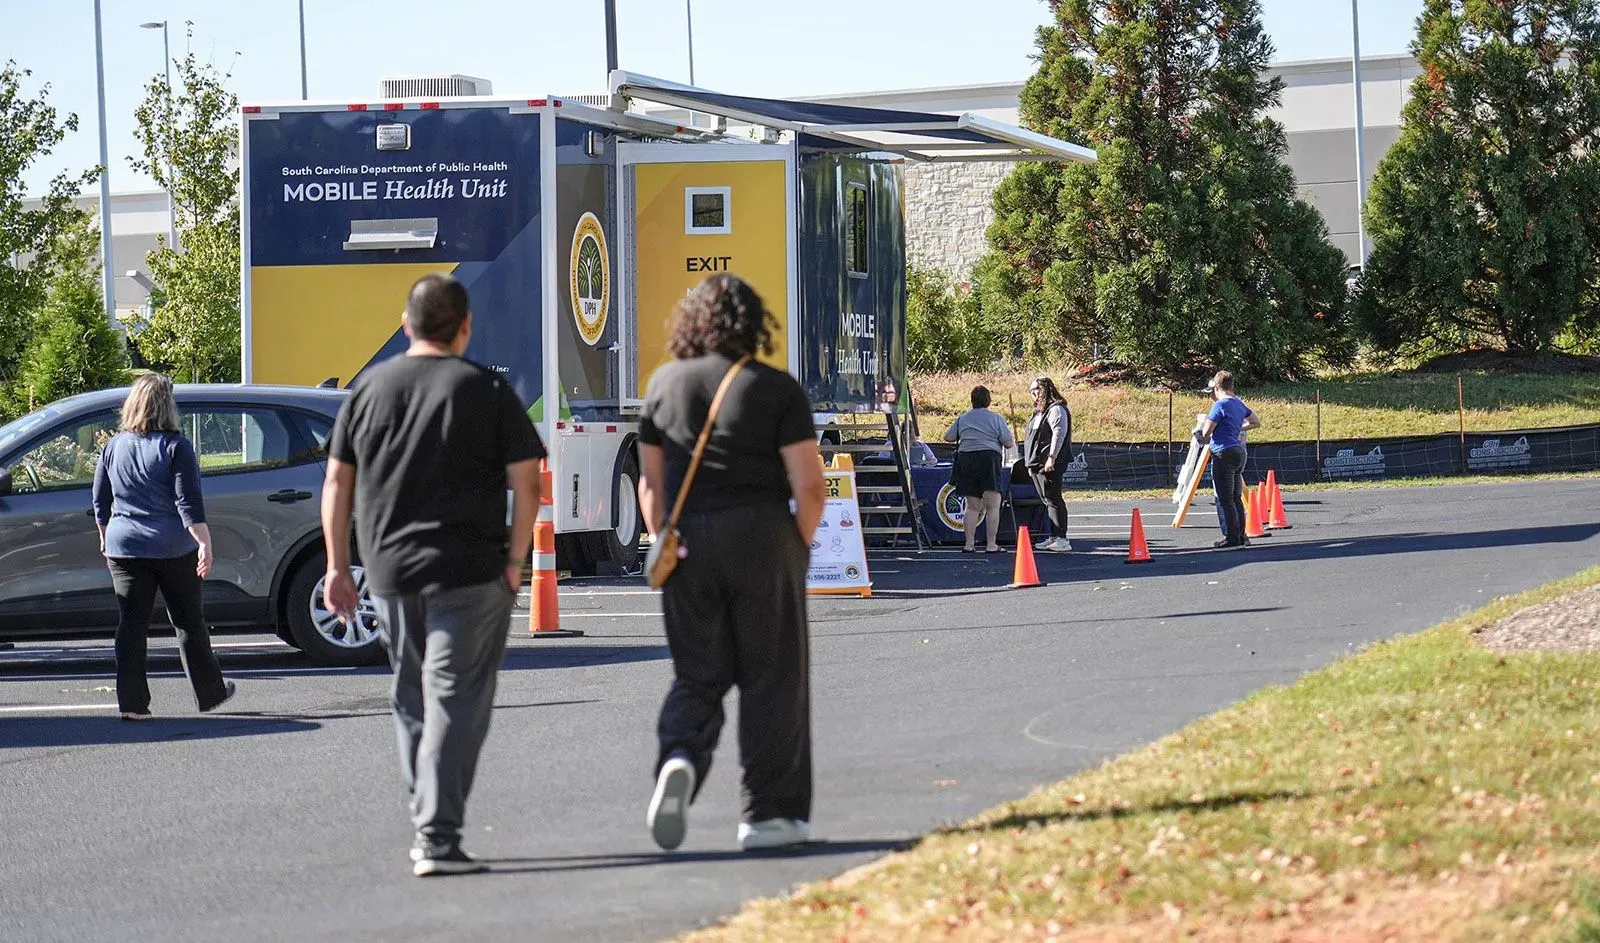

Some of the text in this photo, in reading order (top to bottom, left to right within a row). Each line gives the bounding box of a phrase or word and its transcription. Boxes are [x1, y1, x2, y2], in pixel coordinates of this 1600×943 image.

[282, 161, 508, 176] South Carolina Department of Public Health
[284, 178, 508, 202] MOBILE Health Unit
[686, 256, 732, 272] EXIT
[584, 301, 597, 316] DPH
[841, 312, 875, 339] MOBILE
[837, 348, 861, 375] Health
[1470, 445, 1525, 457] CONSTRUCTION
[1324, 454, 1379, 466] CONSTRUCTION
[824, 478, 841, 487] OT
